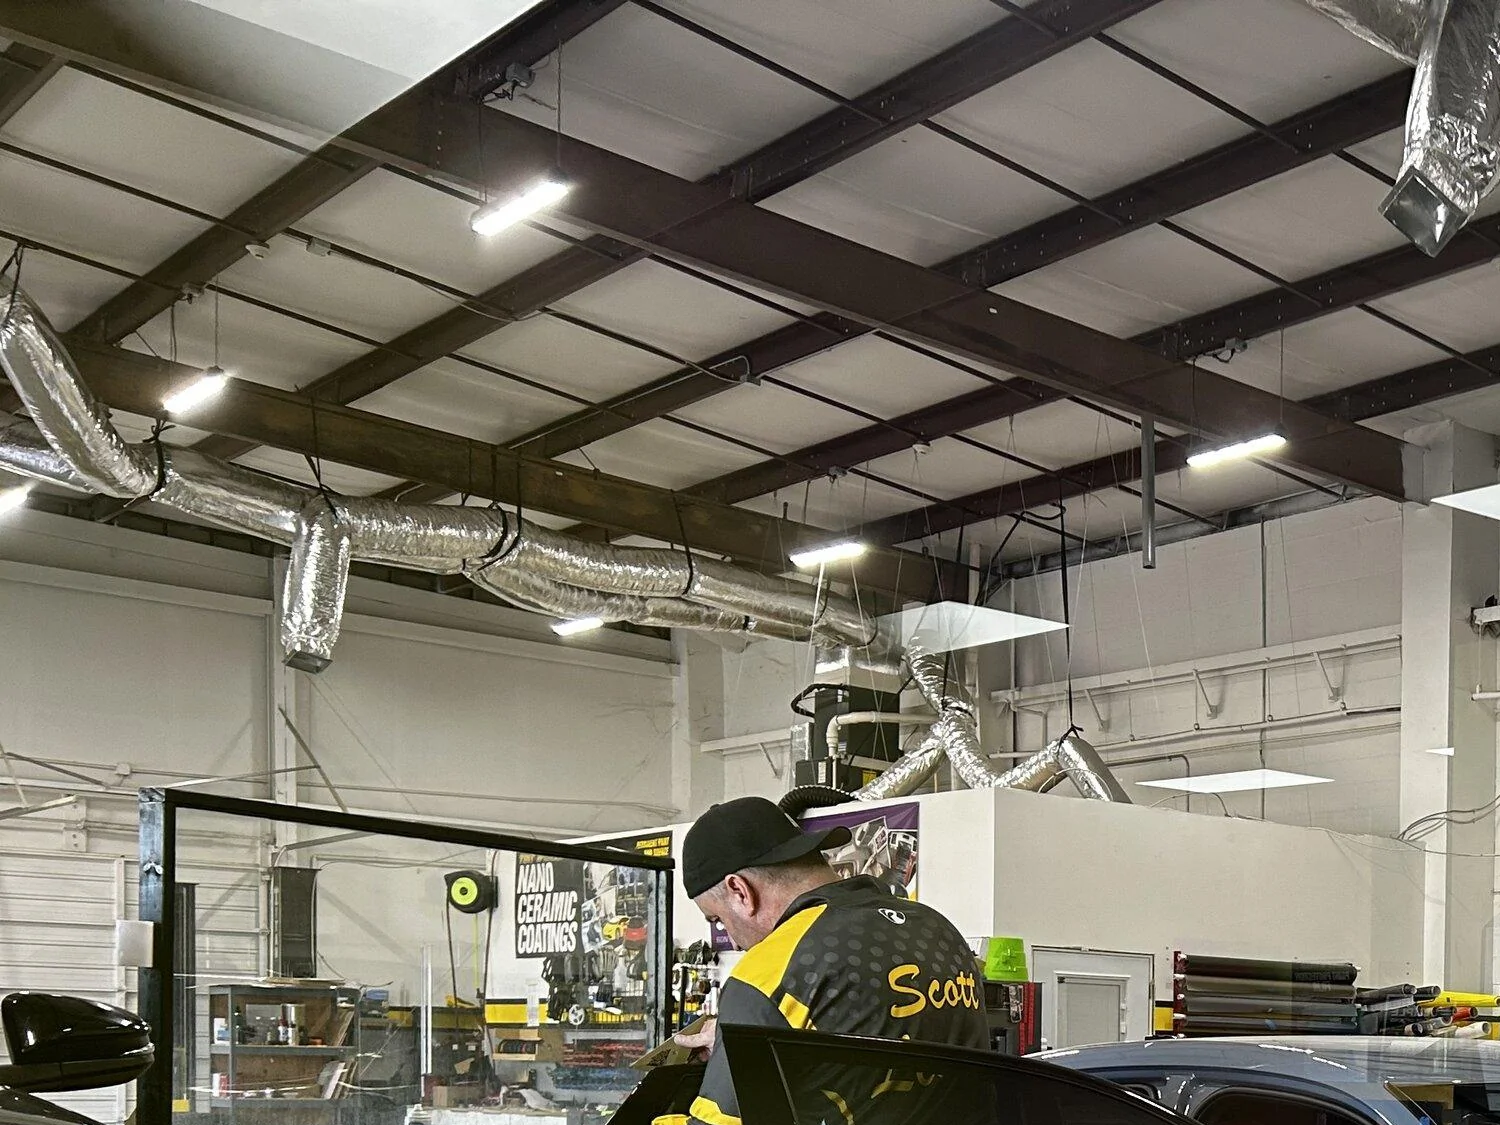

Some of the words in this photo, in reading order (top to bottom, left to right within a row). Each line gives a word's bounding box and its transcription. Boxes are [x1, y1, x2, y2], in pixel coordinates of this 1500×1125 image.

[517, 862, 554, 894] NANO
[517, 891, 578, 924] CERAMIC
[517, 922, 578, 954] COATINGS
[888, 964, 980, 1018] Scott
